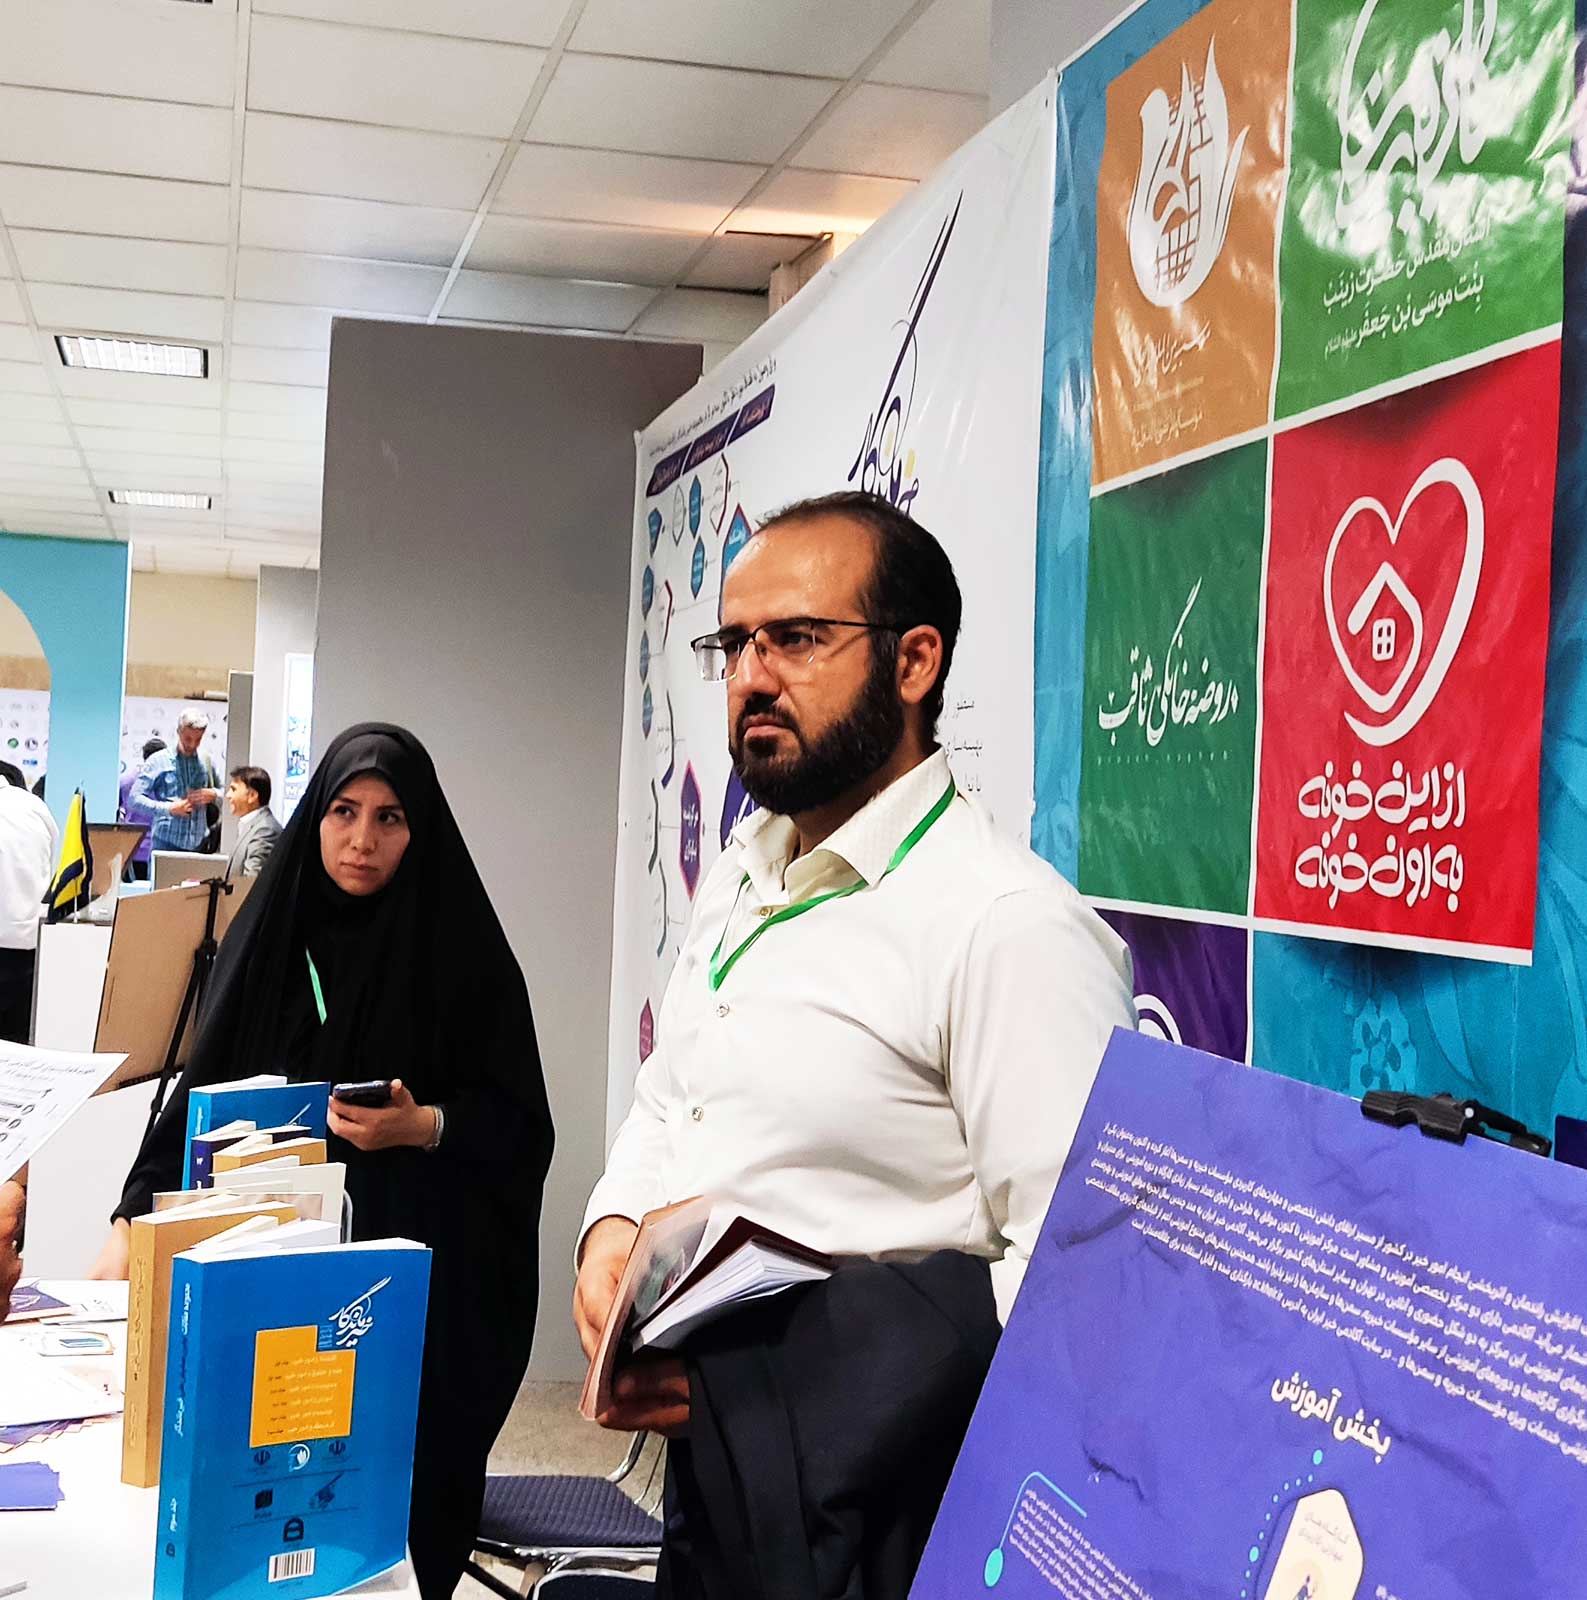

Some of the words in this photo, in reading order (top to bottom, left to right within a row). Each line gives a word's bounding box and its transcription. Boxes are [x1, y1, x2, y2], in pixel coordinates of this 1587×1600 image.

[1298, 760, 1373, 839] خونه
[1374, 760, 1440, 834] این
[1431, 761, 1466, 830] از
[1295, 831, 1369, 910] خونه
[1368, 834, 1432, 908] اون
[1431, 844, 1464, 913] به
[1197, 1206, 1203, 1216] به
[1228, 1199, 1234, 1209] و
[1282, 1199, 1288, 1210] و
[1202, 1208, 1217, 1223] ایران
[1254, 1209, 1260, 1220] به
[1287, 1204, 1316, 1219] تخصصی
[1214, 1217, 1225, 1226] خیر
[1315, 1213, 1335, 1227] دانش
[1299, 1230, 1324, 1246] آموزش
[1354, 1231, 1376, 1245] مسیر
[1374, 1236, 1384, 1250] از
[1321, 1239, 1338, 1254] مرکز
[1382, 1243, 1406, 1256] کشور
[1283, 1249, 1304, 1261] کشور
[1402, 1251, 1413, 1261] در
[1412, 1256, 1428, 1266] خیر
[1380, 1266, 1387, 1278] و
[1427, 1262, 1448, 1274] امور
[1332, 1270, 1350, 1284] سایر
[1386, 1270, 1416, 1287] آموزش
[1349, 1279, 1356, 1290] و
[1356, 1280, 1377, 1299] تهران
[1375, 1292, 1385, 1302] در
[1447, 1295, 1469, 1312] مرکز
[1504, 1293, 1512, 1305] و
[1301, 1305, 1308, 1317] به
[1307, 1308, 1325, 1325] ایران
[1361, 1310, 1383, 1326] خیریه
[1407, 1305, 1414, 1318] و
[1468, 1305, 1481, 1318] دو
[1322, 1319, 1337, 1330] خیر
[1444, 1320, 1465, 1339] شکل
[1417, 1338, 1438, 1354] سایر
[1464, 1333, 1477, 1345] دو
[1478, 1337, 1488, 1352] به
[1380, 1349, 1392, 1358] در
[1437, 1345, 1448, 1359] از
[1486, 1342, 1509, 1359] مرکز
[1398, 1356, 1405, 1368] و
[1509, 1353, 1527, 1368] این
[1434, 1375, 1442, 1387] و
[1443, 1377, 1465, 1395] خیریه
[1270, 1371, 1341, 1424] آموزش
[1512, 1384, 1520, 1397] و
[1332, 1408, 1391, 1464] بخش
